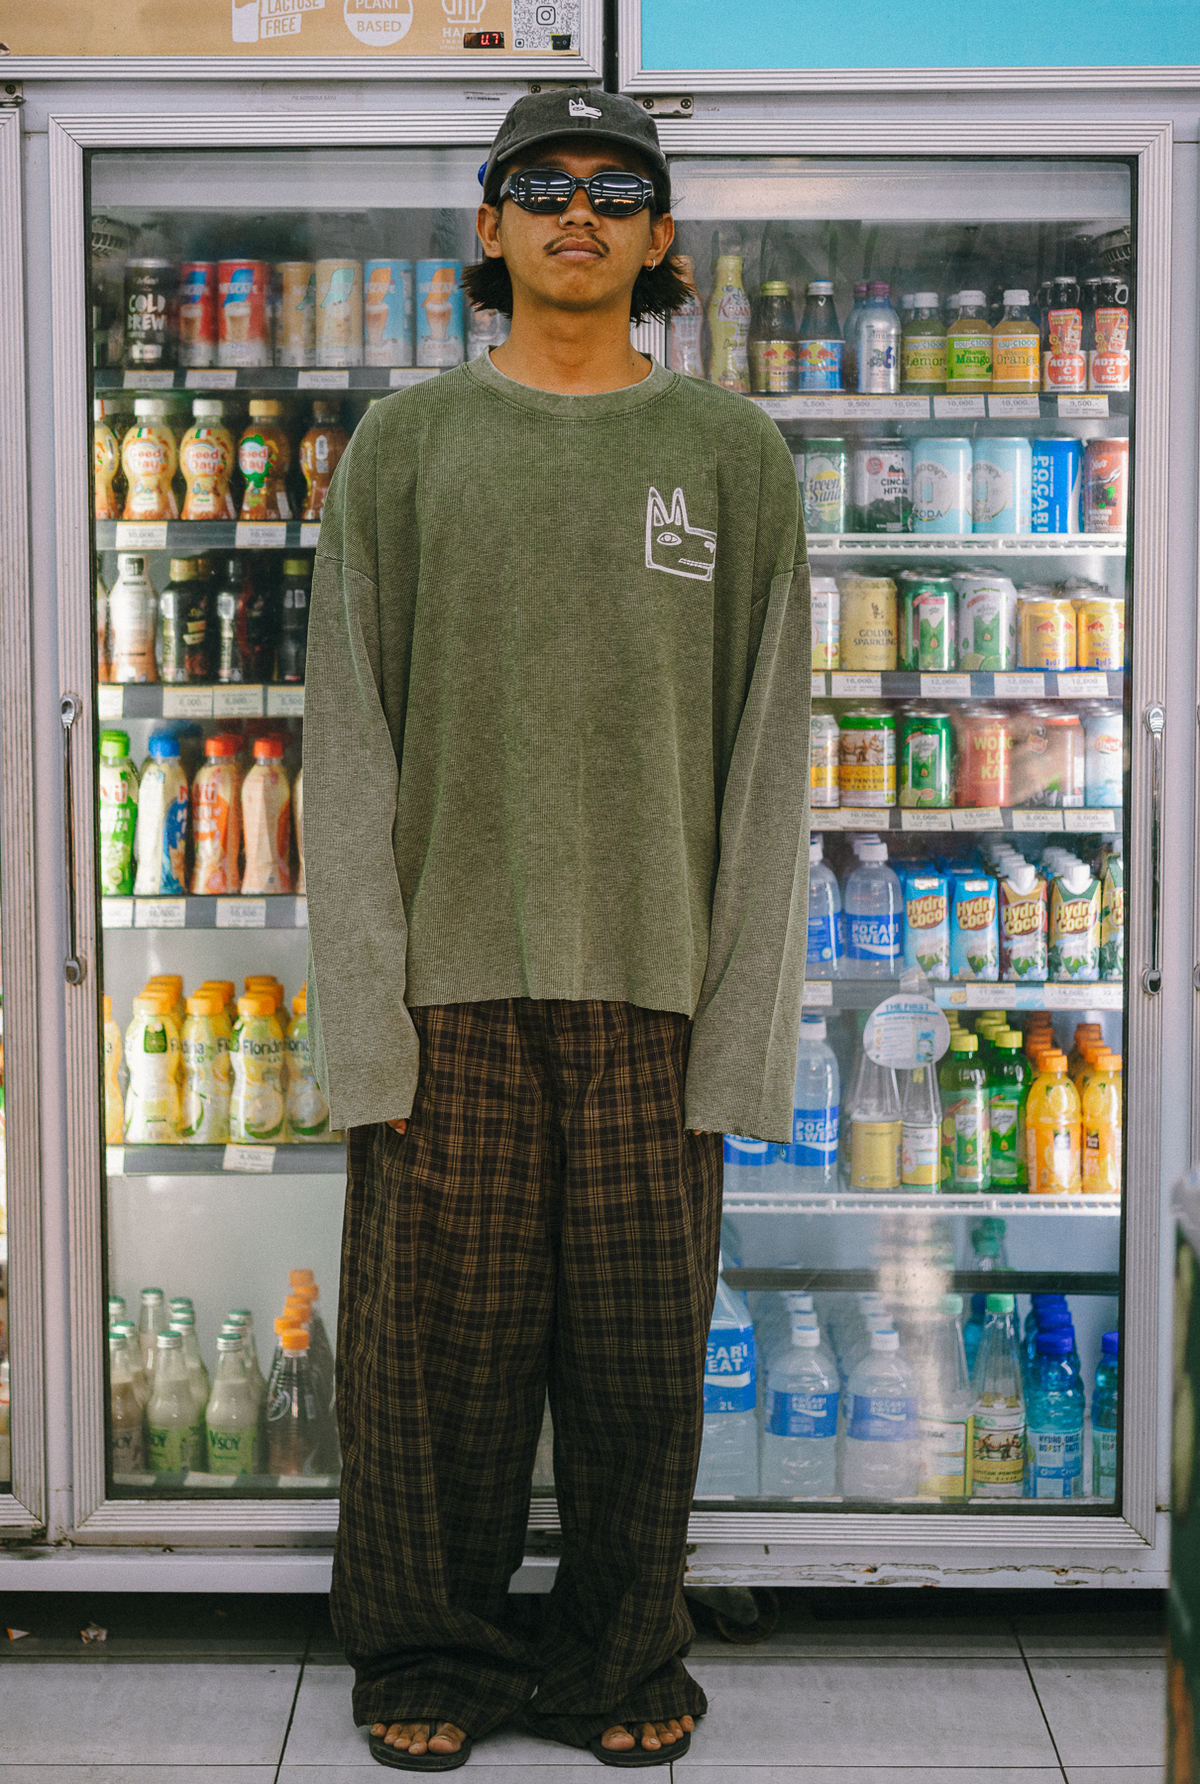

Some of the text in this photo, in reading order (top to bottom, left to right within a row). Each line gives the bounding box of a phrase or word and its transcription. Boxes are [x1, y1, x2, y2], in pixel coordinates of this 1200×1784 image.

[356, 0, 399, 9] PLANT
[266, 17, 297, 36] FREE
[357, 20, 402, 32] BASED
[129, 293, 166, 313] COLD
[128, 314, 166, 331] BREW
[906, 355, 946, 367] Lemon
[956, 355, 991, 366] Mango
[997, 354, 1038, 367] Orange
[1063, 366, 1073, 375] C
[1106, 366, 1116, 374] C
[130, 448, 162, 463] Good
[187, 448, 220, 463] Good
[239, 449, 266, 461] Good
[137, 462, 160, 477] Day
[193, 462, 217, 477] Day
[242, 463, 264, 477] Day
[1037, 456, 1049, 531] POCARI
[859, 629, 894, 638] GOLDEN
[853, 638, 897, 647] SPARKLING
[974, 736, 1013, 751] WONG
[986, 751, 1006, 764] LO
[981, 765, 1008, 780] KAT
[907, 894, 947, 917] Hydro
[957, 896, 996, 917] Hydro
[1003, 901, 1043, 922] Hydro
[1055, 900, 1097, 922] Hydro
[910, 910, 945, 930] Coco
[960, 911, 994, 931] Coco
[1005, 914, 1041, 935] Coco
[1058, 913, 1095, 934] Coco
[885, 1003, 929, 1011] THE FIRST
[706, 1343, 748, 1360] CARI
[707, 1356, 744, 1373] EAT
[719, 1401, 736, 1411] 2L
